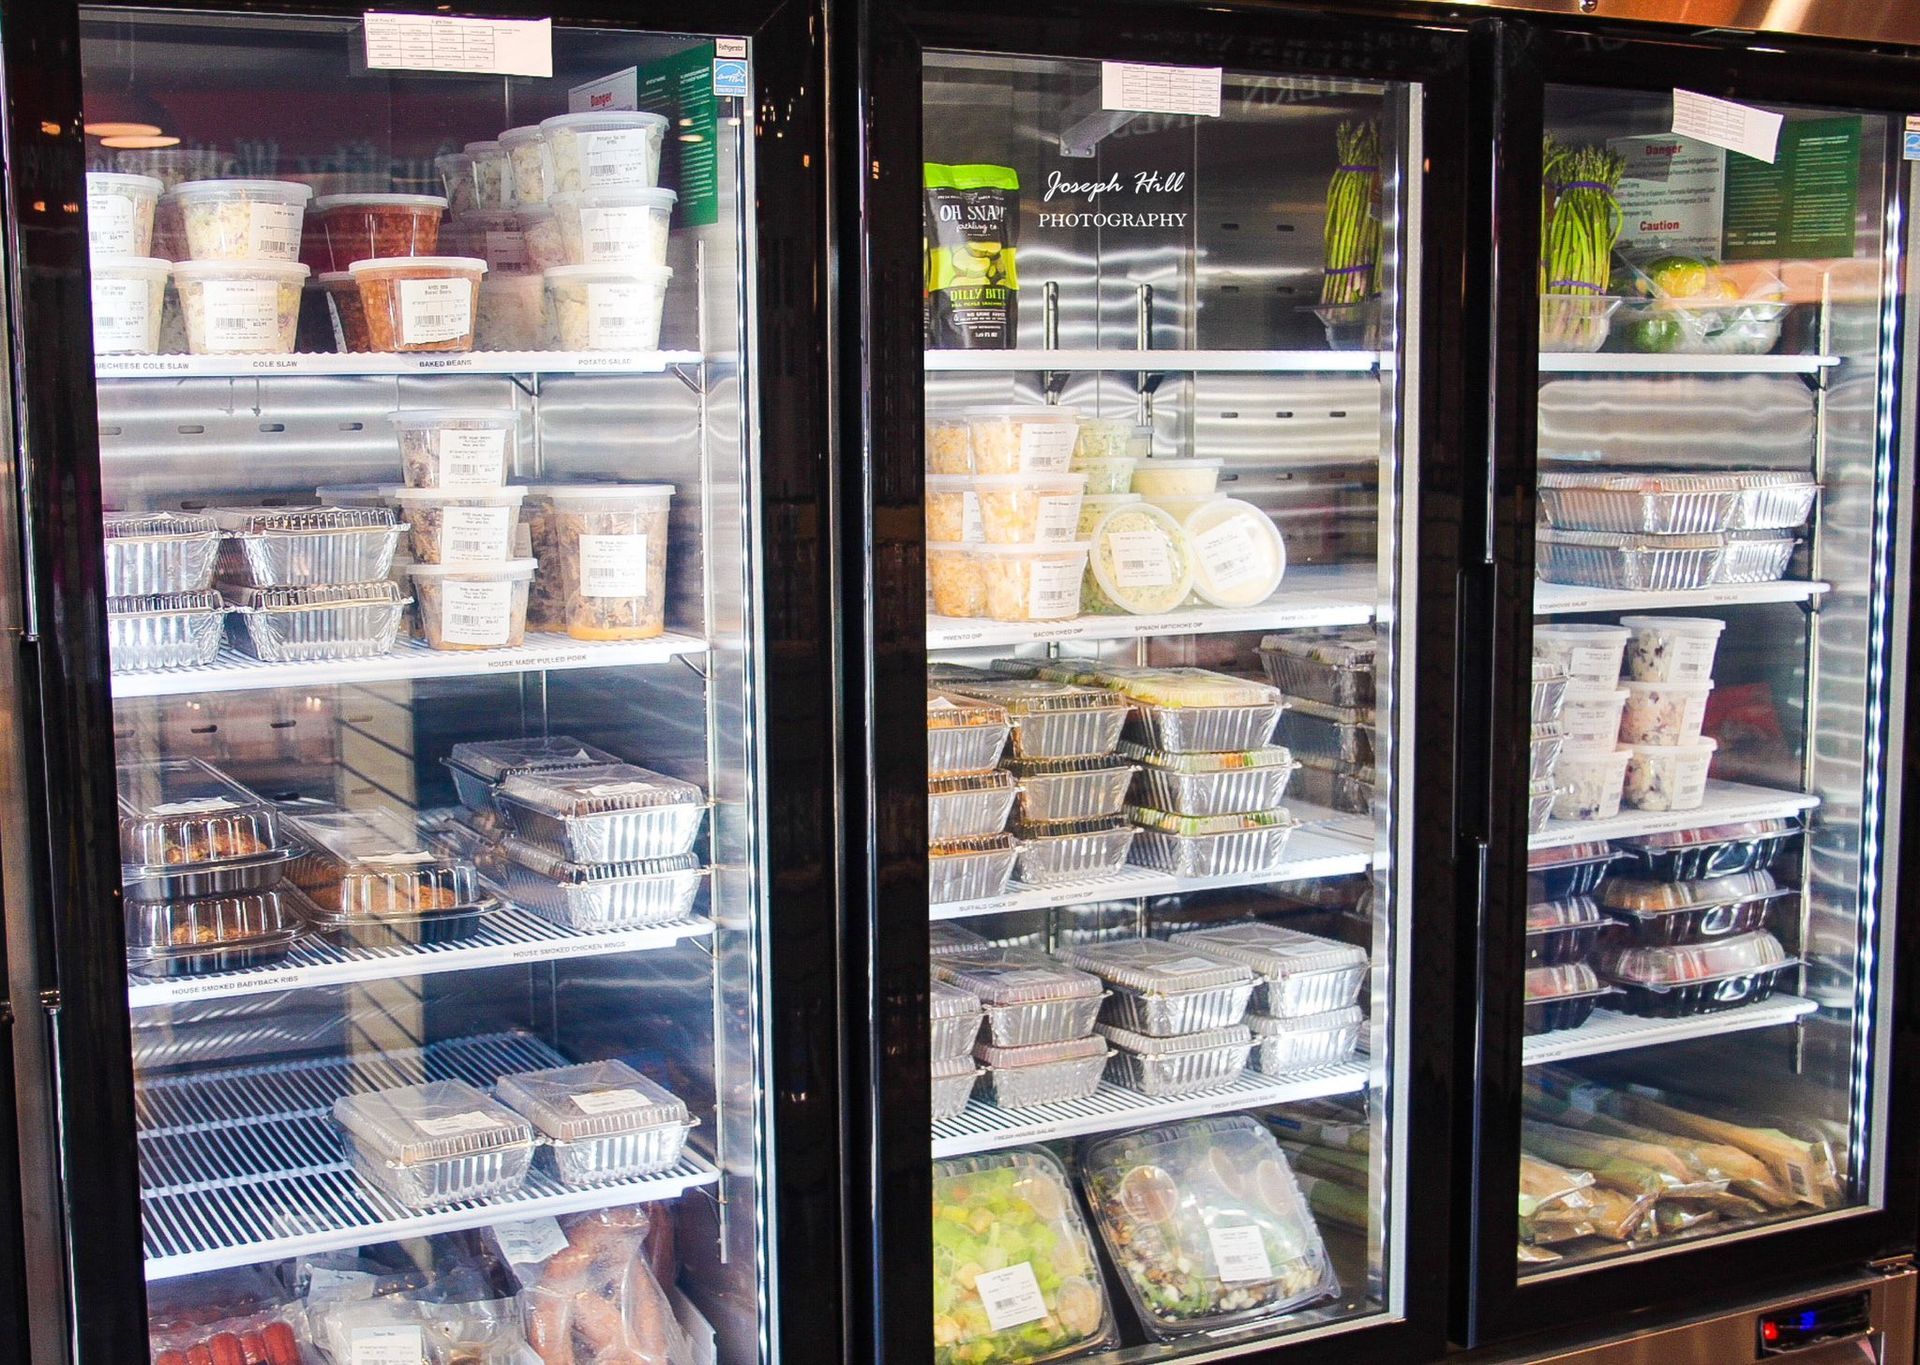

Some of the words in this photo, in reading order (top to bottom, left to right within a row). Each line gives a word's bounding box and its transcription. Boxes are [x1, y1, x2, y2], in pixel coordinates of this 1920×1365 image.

[590, 92, 612, 107] Danger
[1645, 145, 1682, 155] Danger
[940, 205, 962, 221] OH
[1640, 220, 1680, 231] Caution
[950, 288, 983, 301] DILLY
[143, 362, 166, 370] COLE
[167, 362, 190, 370] SLAW
[276, 360, 298, 368] SLAW
[446, 359, 472, 367] BEANS
[1135, 624, 1160, 632] SPINACH
[1160, 622, 1192, 630] ARTICHOKE
[1033, 630, 1055, 638] BACON
[488, 659, 513, 667] HOUSE
[515, 657, 534, 665] MADE
[537, 655, 565, 664] PULLED
[959, 903, 987, 911] BUFFALO
[513, 950, 538, 958] HOUSE
[540, 946, 571, 955] SMOKED
[571, 943, 603, 952] CHICKEN
[201, 983, 235, 992] SMOKED
[236, 978, 279, 989] BABYBACK
[280, 975, 299, 983] RIBS
